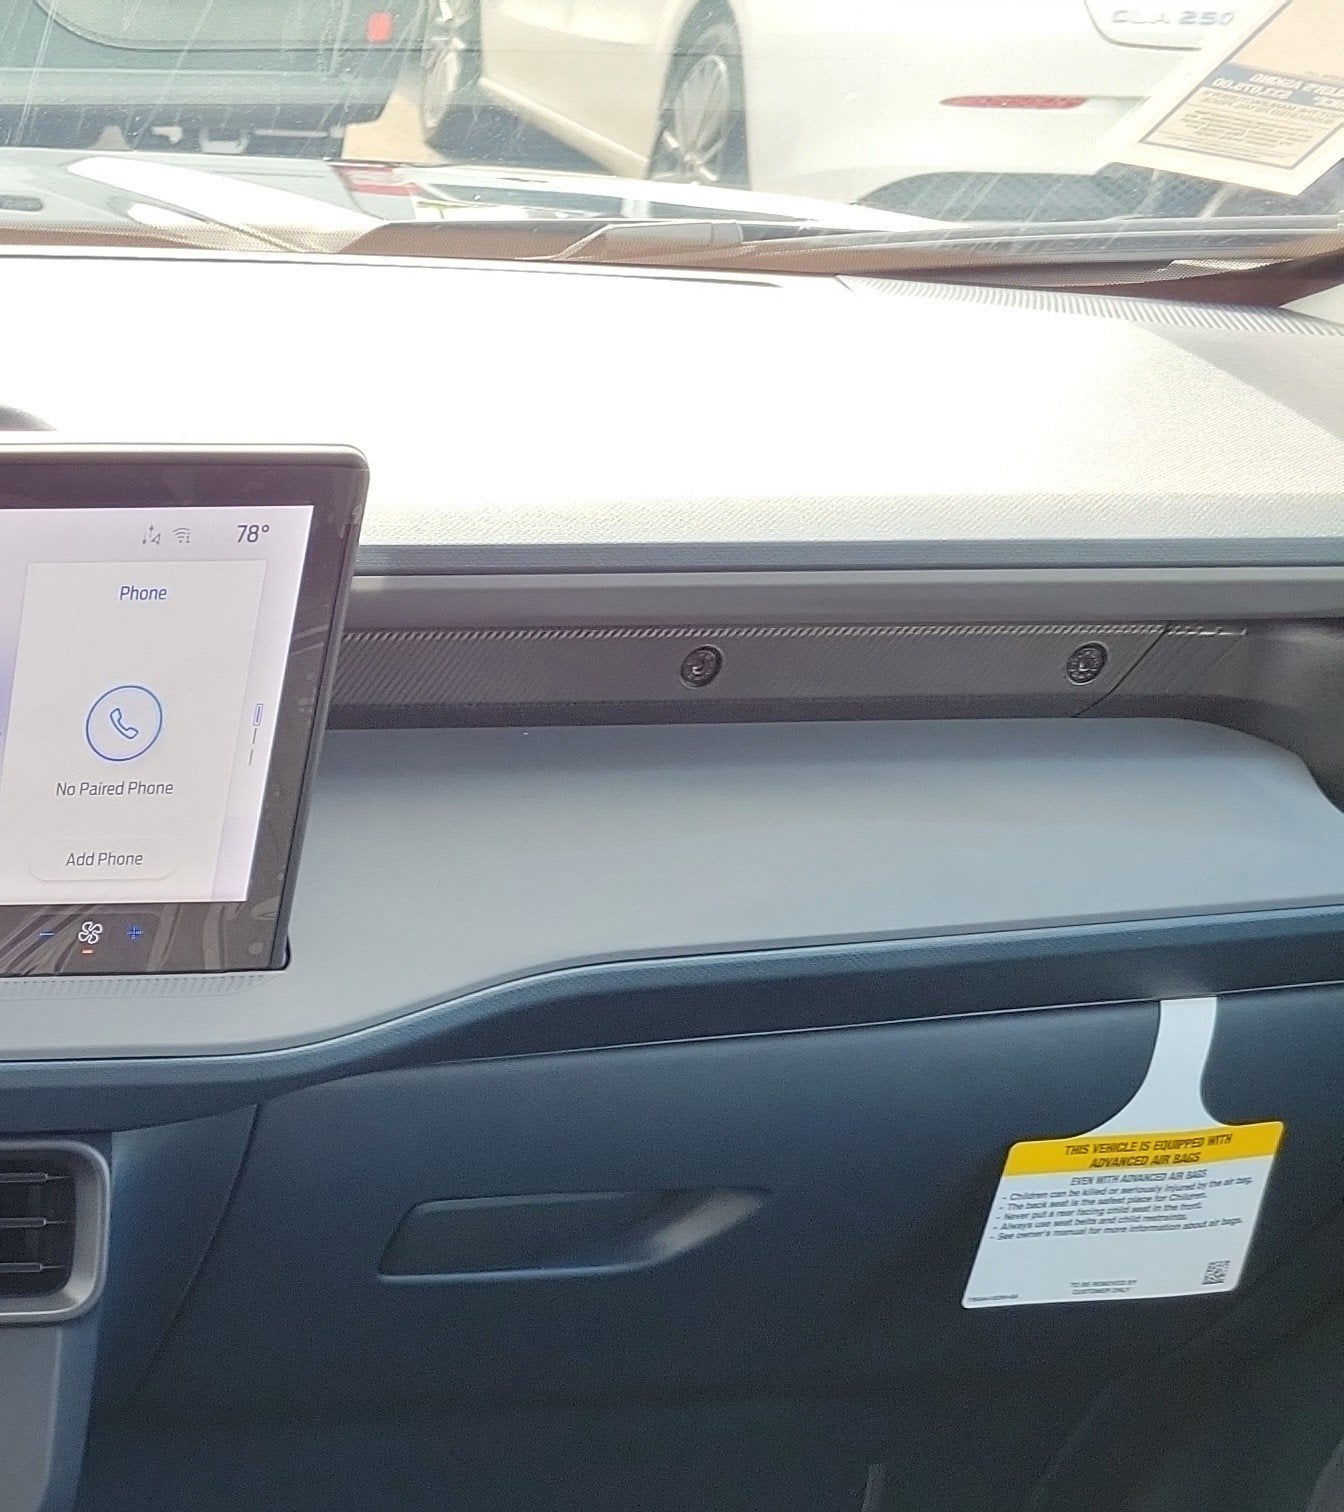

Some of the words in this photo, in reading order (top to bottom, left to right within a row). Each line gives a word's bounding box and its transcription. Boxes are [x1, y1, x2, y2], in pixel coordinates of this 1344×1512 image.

[236, 524, 270, 543] 78°
[119, 585, 167, 601] Phone
[56, 782, 76, 796] No
[79, 781, 124, 796] Paired
[127, 780, 174, 796] Phone
[65, 852, 94, 867] Add
[97, 852, 143, 867] Phone
[1065, 1144, 1091, 1155] THIS
[1092, 1142, 1138, 1154] VEHICLE
[1138, 1141, 1152, 1152] IS
[1153, 1137, 1205, 1150] EQUIPPED
[1207, 1133, 1233, 1146] WITH
[1089, 1155, 1149, 1168] ADVANCED
[1151, 1154, 1171, 1165] AIR
[1172, 1152, 1202, 1163] BAGS
